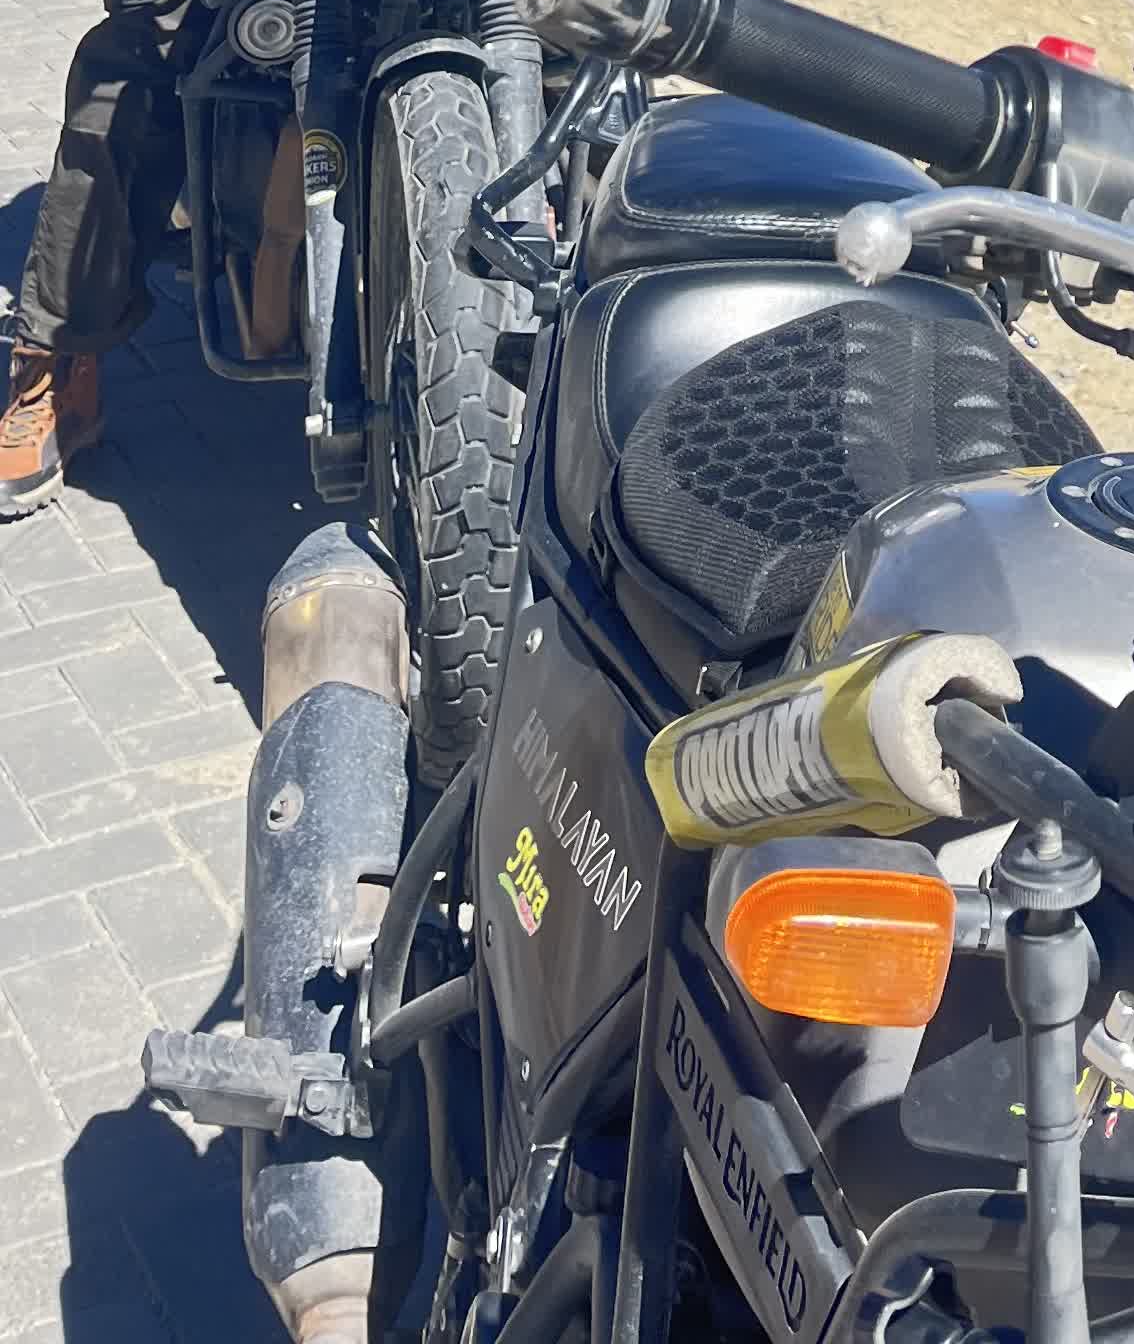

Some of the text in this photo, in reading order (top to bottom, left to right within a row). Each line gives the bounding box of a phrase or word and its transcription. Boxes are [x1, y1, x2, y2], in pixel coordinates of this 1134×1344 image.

[512, 708, 643, 931] HIMALAYAN
[681, 691, 843, 825] PROTAPER
[666, 999, 807, 1335] ROYAL ENFIELD
